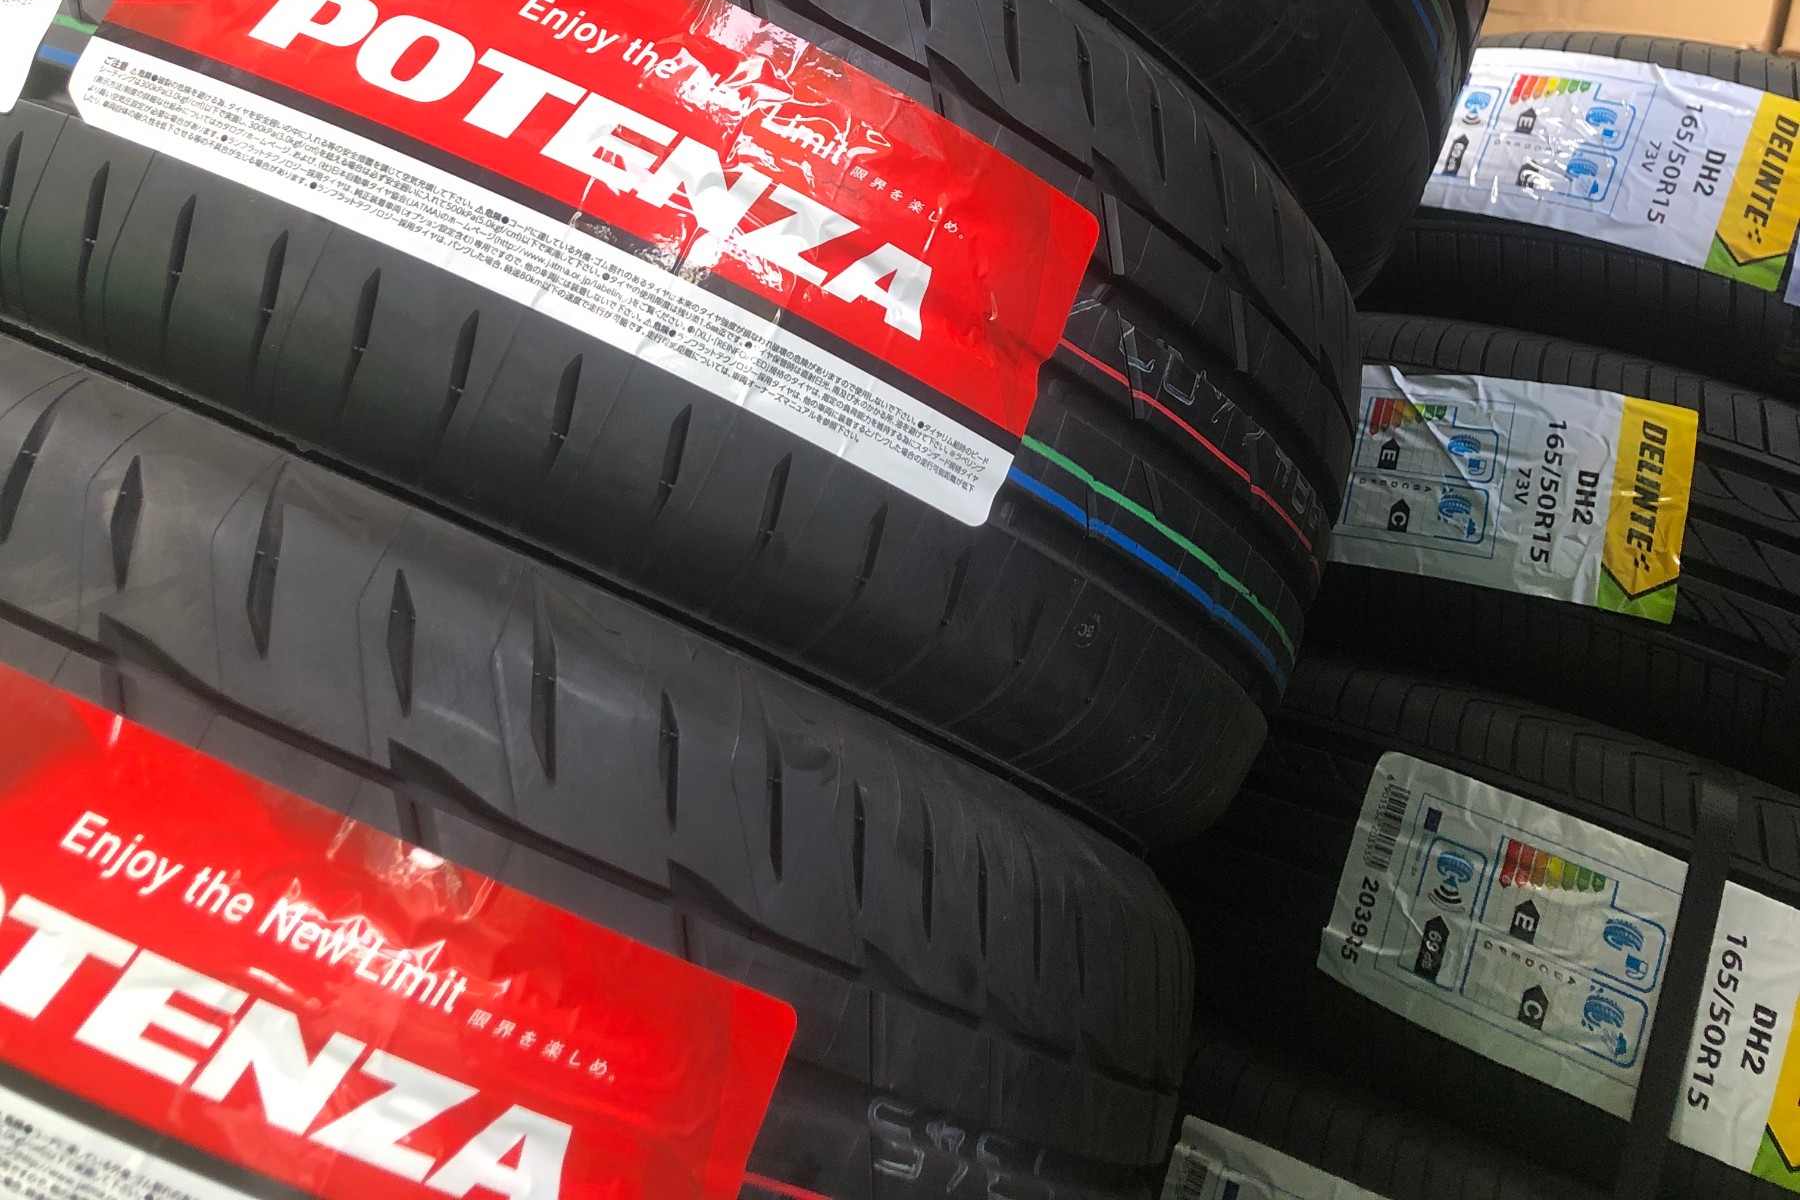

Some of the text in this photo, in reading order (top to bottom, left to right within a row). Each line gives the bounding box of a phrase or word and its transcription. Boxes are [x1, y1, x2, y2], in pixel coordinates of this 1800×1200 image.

[622, 36, 679, 80] the
[1518, 115, 1533, 129] E
[1641, 140, 1663, 173] 73V
[1646, 104, 1704, 226] 165/50R15
[1693, 151, 1727, 197] DH2
[1744, 113, 1800, 228] DELINTE
[1381, 448, 1396, 462] E
[1514, 467, 1532, 506] 73V
[1530, 420, 1568, 564] 165/50R15
[1571, 469, 1600, 526] DH2
[1625, 419, 1668, 555] DELINTE
[1390, 511, 1406, 526] C
[59, 809, 470, 1014] Enjoy the New Limit
[1514, 911, 1533, 932] E
[1523, 999, 1544, 1020] C
[1687, 933, 1748, 1111] 165/50R15
[467, 1007, 617, 1084] 限界を楽しめ。
[1740, 1003, 1778, 1076] DH2
